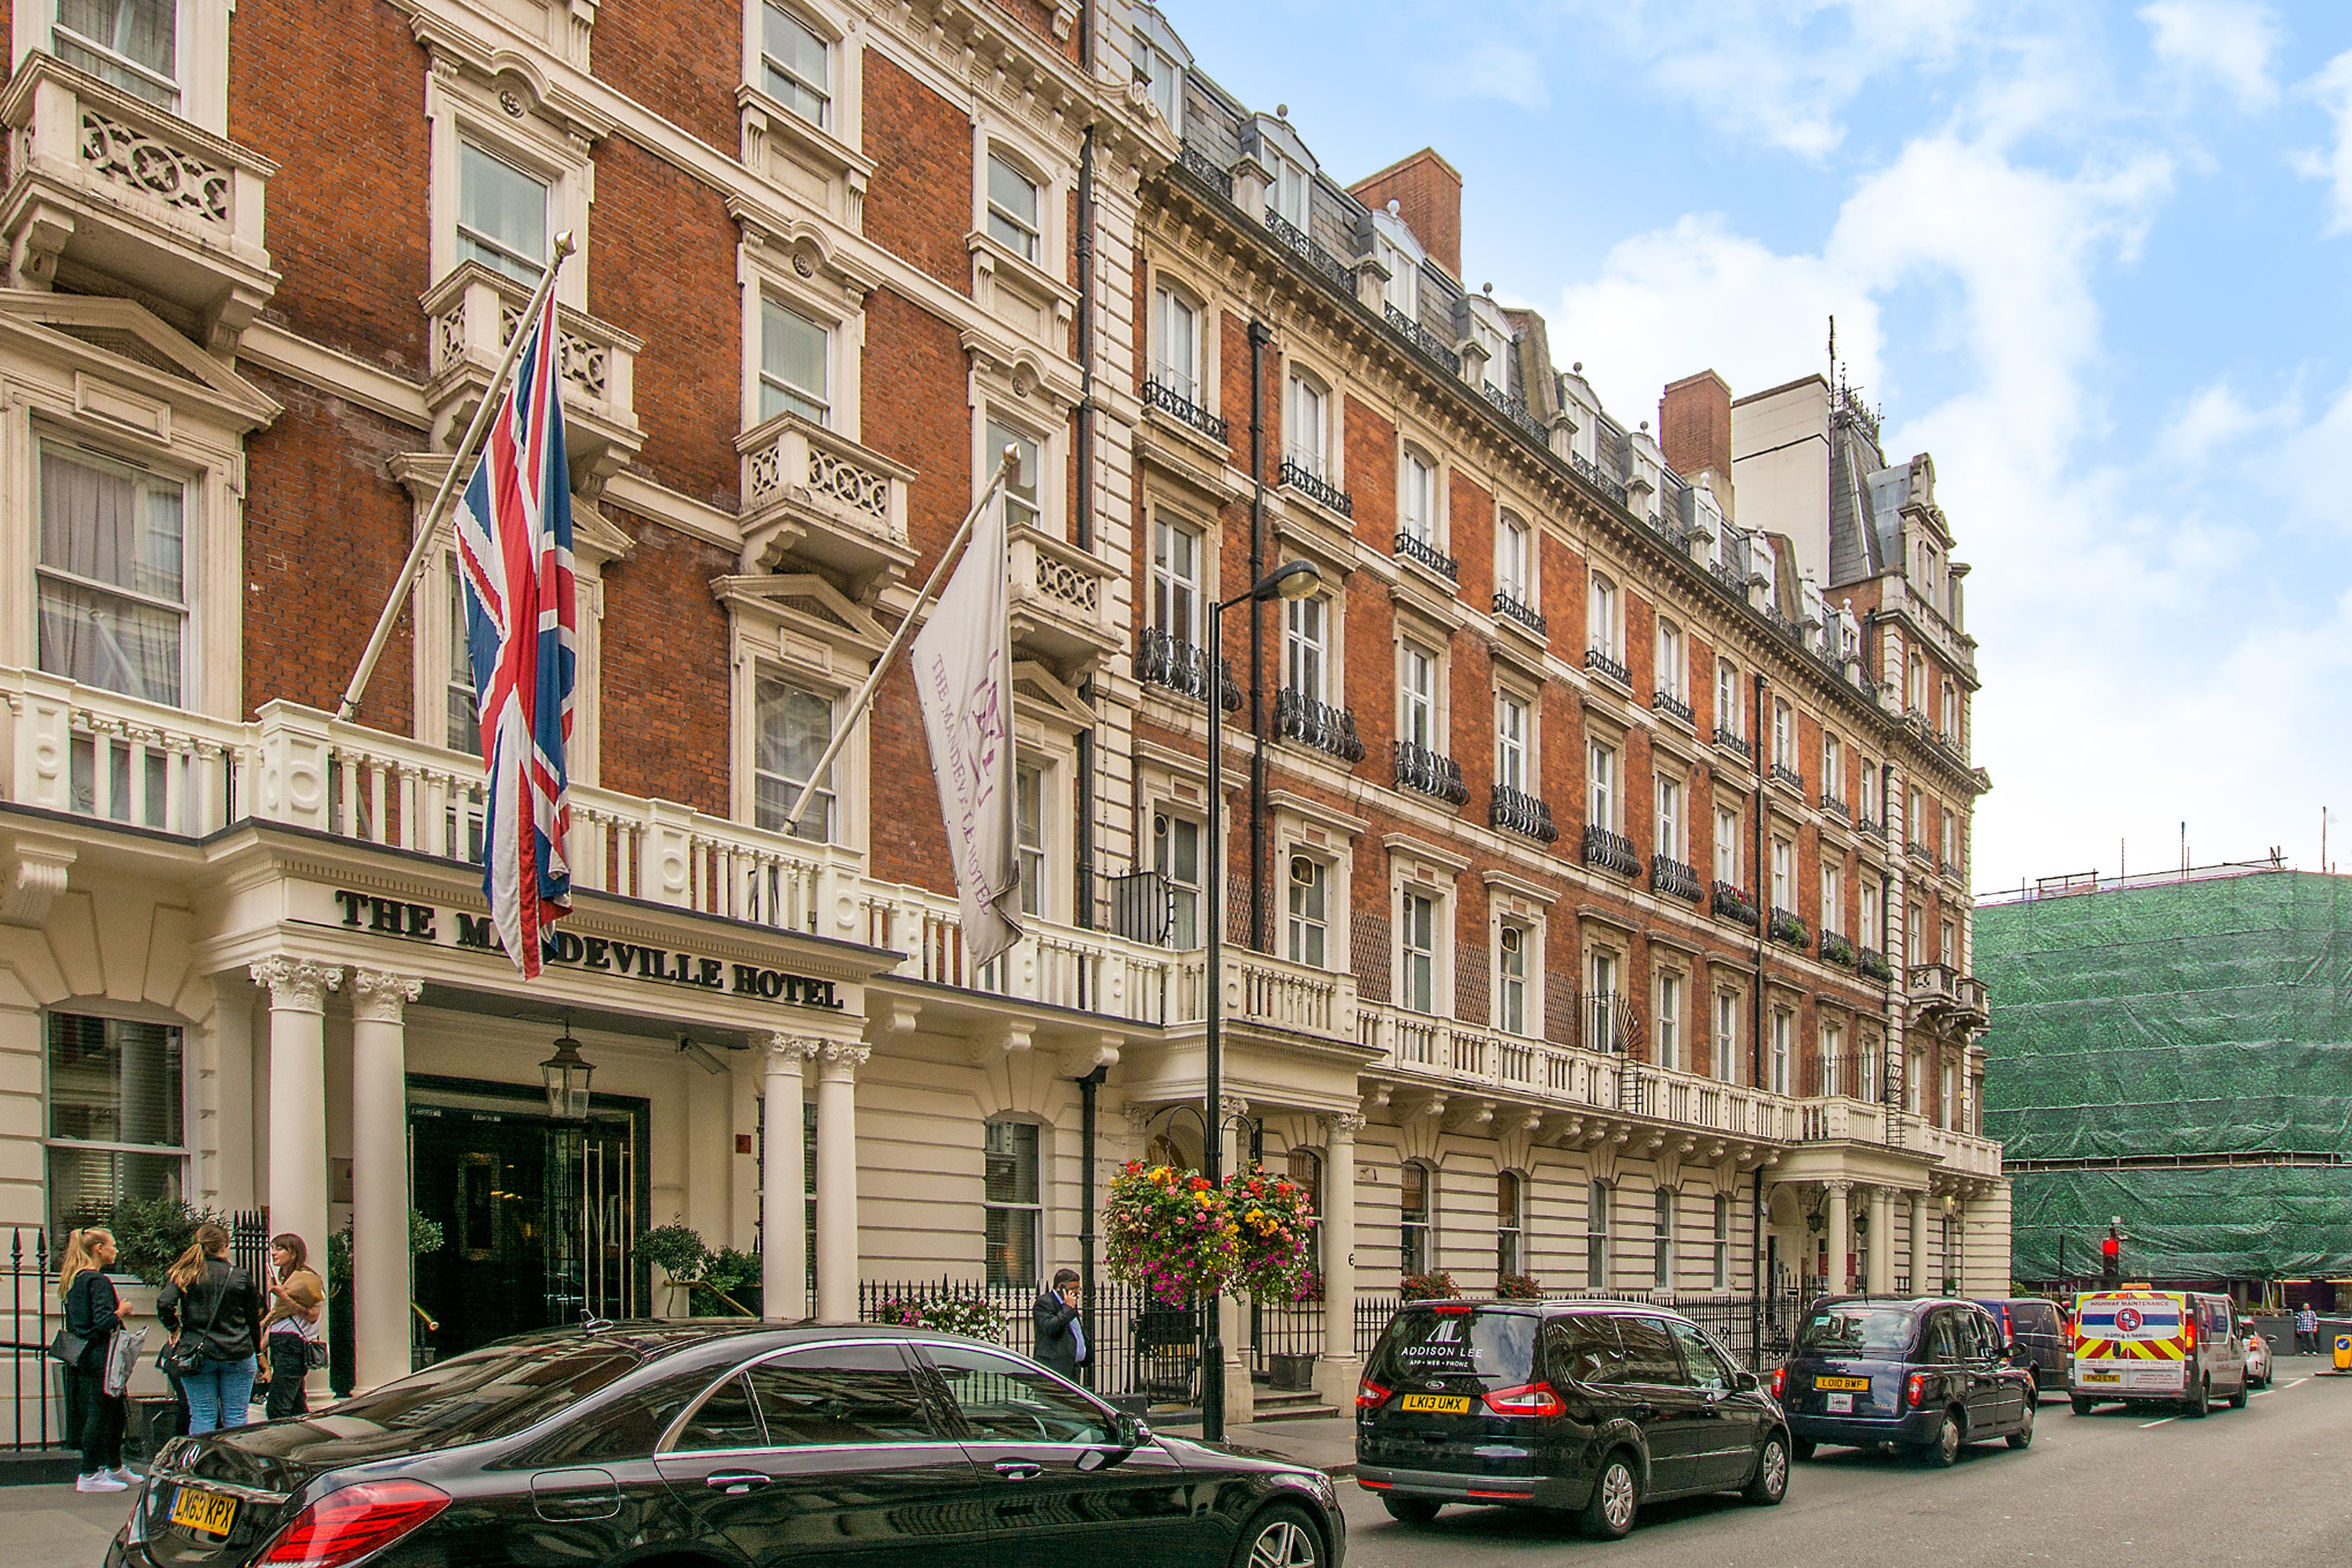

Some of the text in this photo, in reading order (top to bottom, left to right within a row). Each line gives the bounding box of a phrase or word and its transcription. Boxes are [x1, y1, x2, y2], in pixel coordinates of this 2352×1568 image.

[931, 653, 949, 701] THE
[335, 890, 844, 1009] THE MDEVILLE HOTEL
[1401, 1346, 1484, 1358] ADDISON LEE
[1409, 1396, 1462, 1410] LK13 UMX
[204, 1497, 235, 1529] KPX
